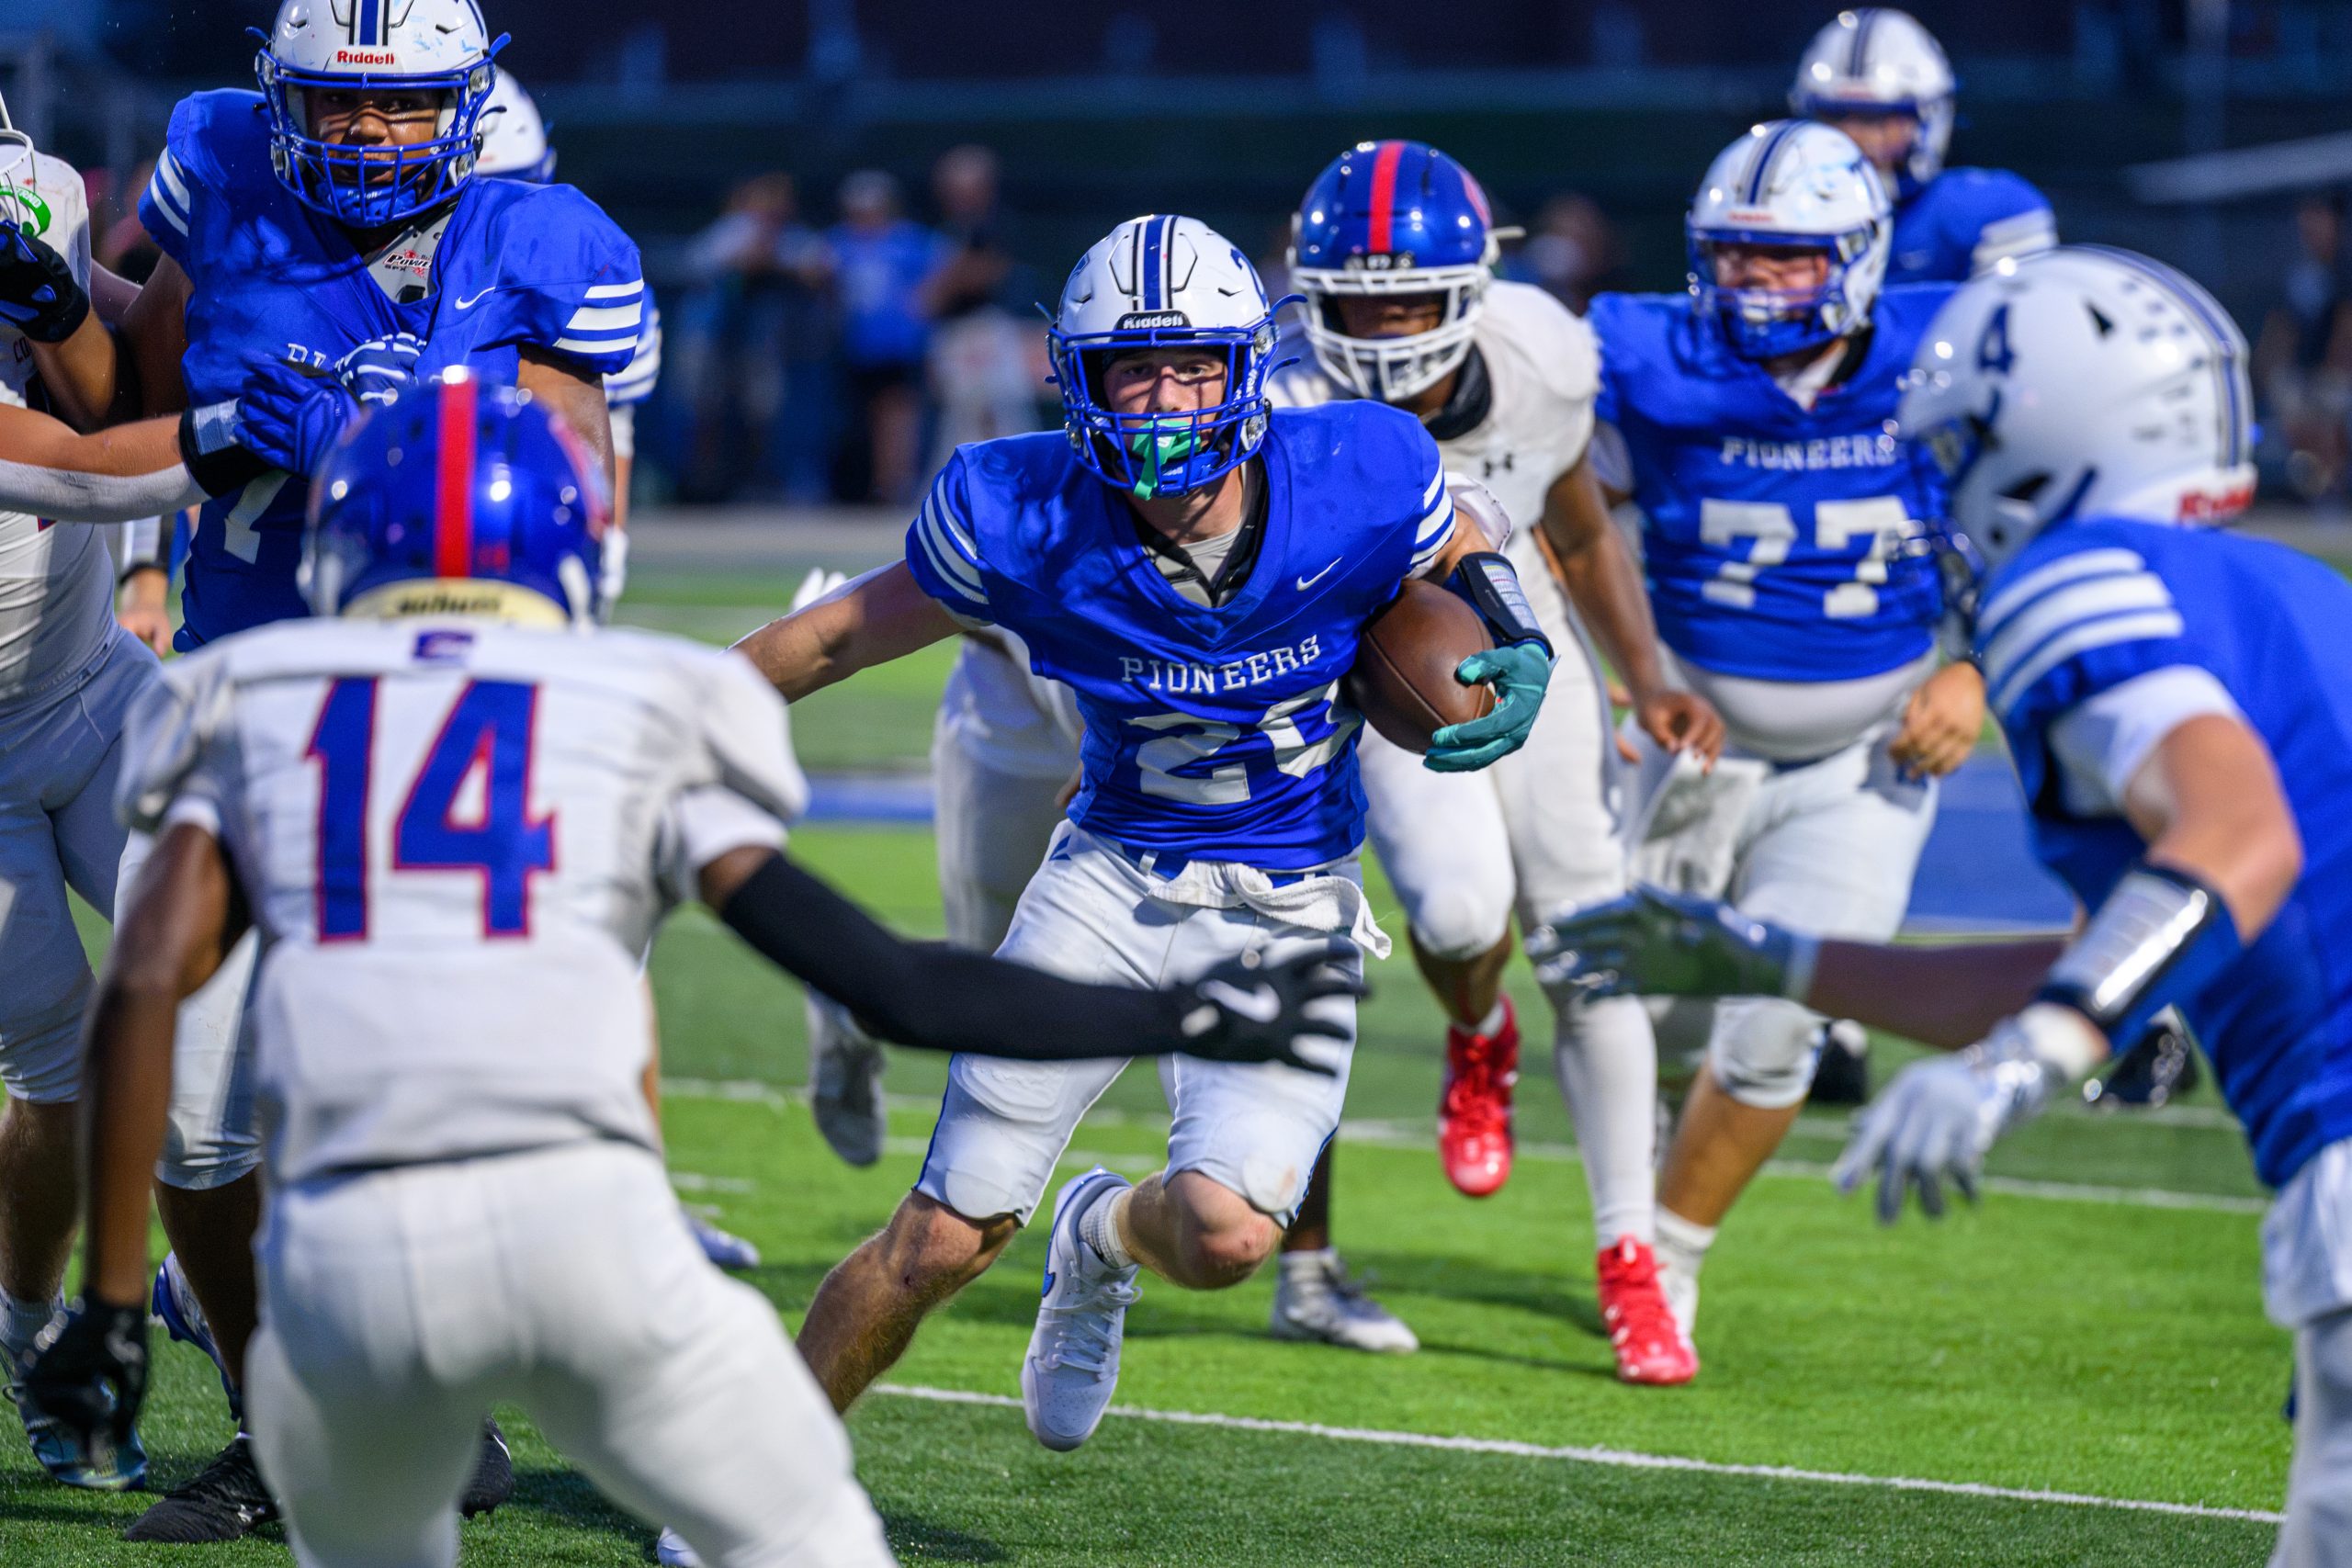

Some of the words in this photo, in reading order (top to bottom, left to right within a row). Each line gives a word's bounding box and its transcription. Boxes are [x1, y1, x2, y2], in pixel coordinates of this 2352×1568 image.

[337, 51, 394, 64] Riddell
[1123, 314, 1184, 329] Riddell
[1975, 303, 2018, 375] 4
[1721, 435, 1896, 470] PIONEERS
[1700, 494, 1911, 620] 77
[1119, 634, 1323, 694] PIONEERS
[302, 673, 560, 943] 14
